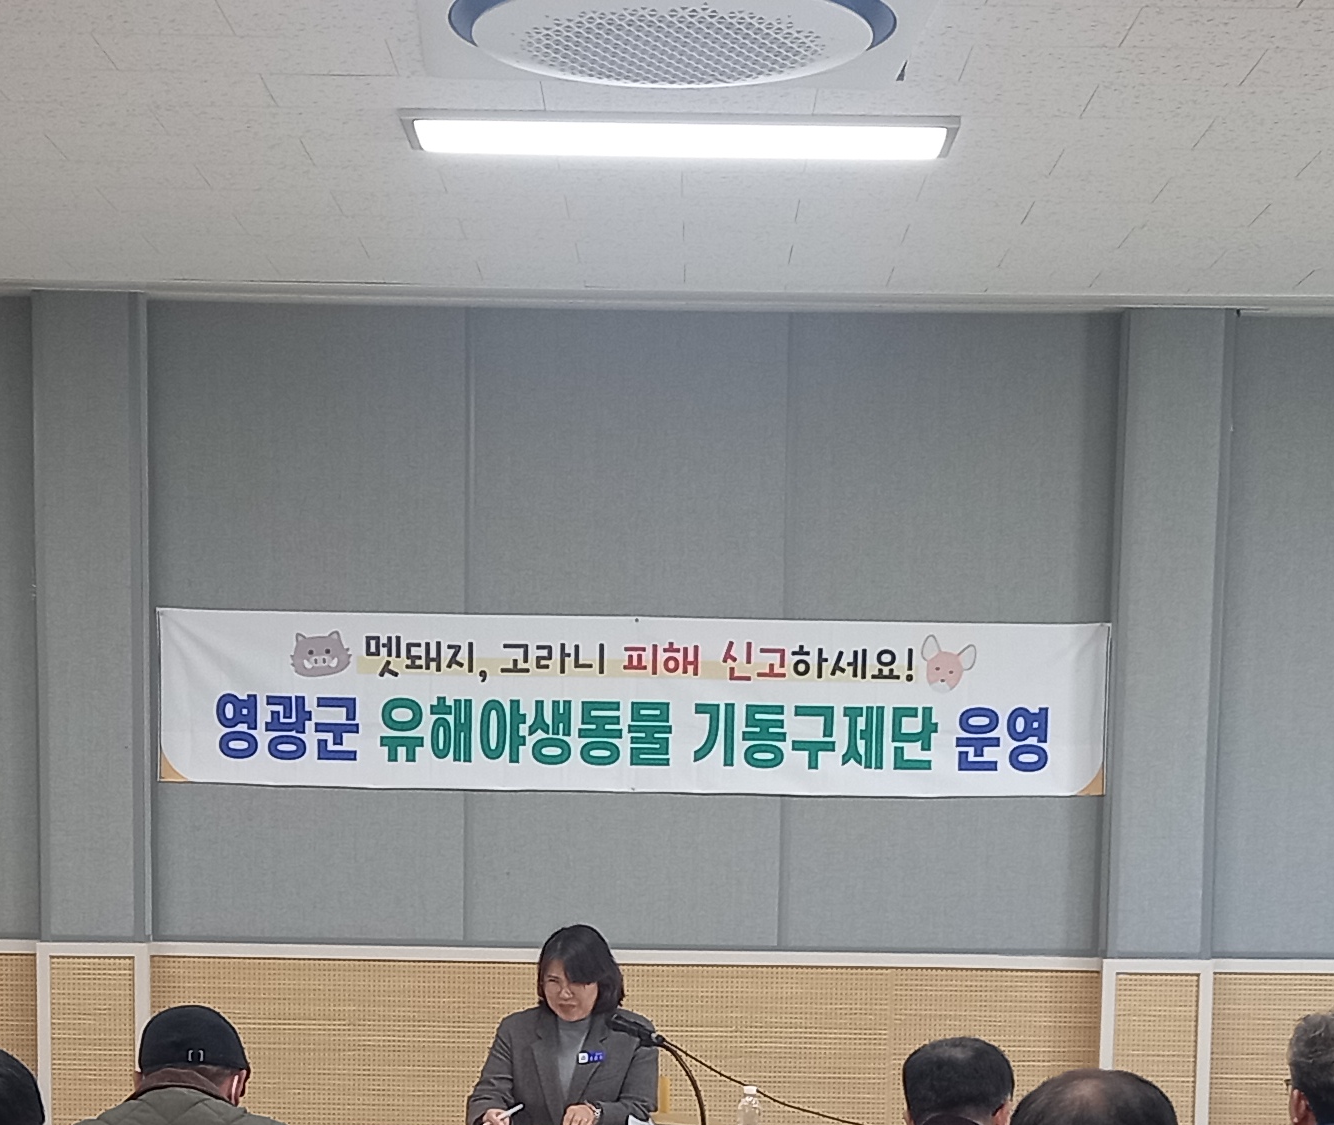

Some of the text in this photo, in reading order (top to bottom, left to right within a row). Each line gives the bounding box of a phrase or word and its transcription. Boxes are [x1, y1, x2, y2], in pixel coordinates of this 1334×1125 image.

[364, 635, 915, 683] 멧돼지, 고라니 피해 신고하세요!
[215, 692, 1050, 773] 영광군 유해야생동물 기동구제단 운영
